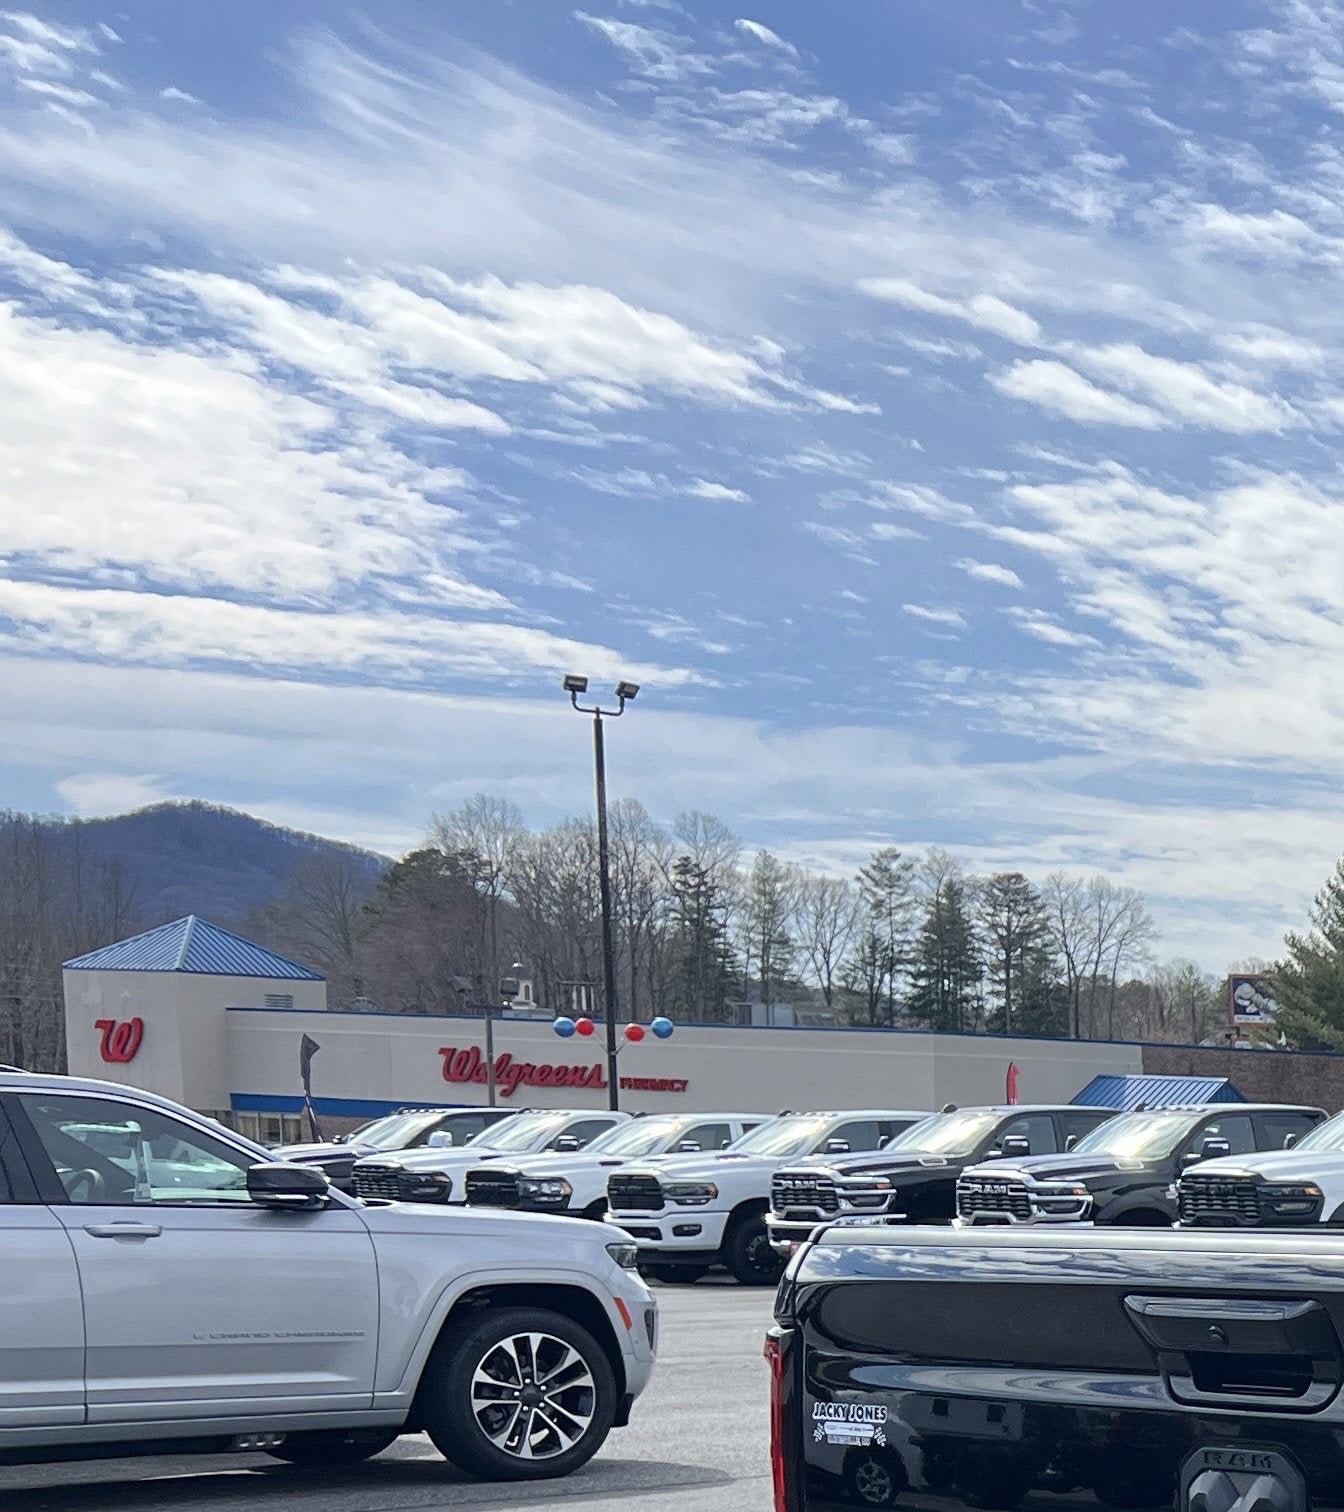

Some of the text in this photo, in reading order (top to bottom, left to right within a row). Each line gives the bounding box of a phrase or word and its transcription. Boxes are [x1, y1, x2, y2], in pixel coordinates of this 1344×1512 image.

[95, 1017, 144, 1062] W
[438, 1046, 608, 1097] Walgreens
[812, 1402, 887, 1423] JACKY JONES
[1203, 1451, 1273, 1469] RAM
